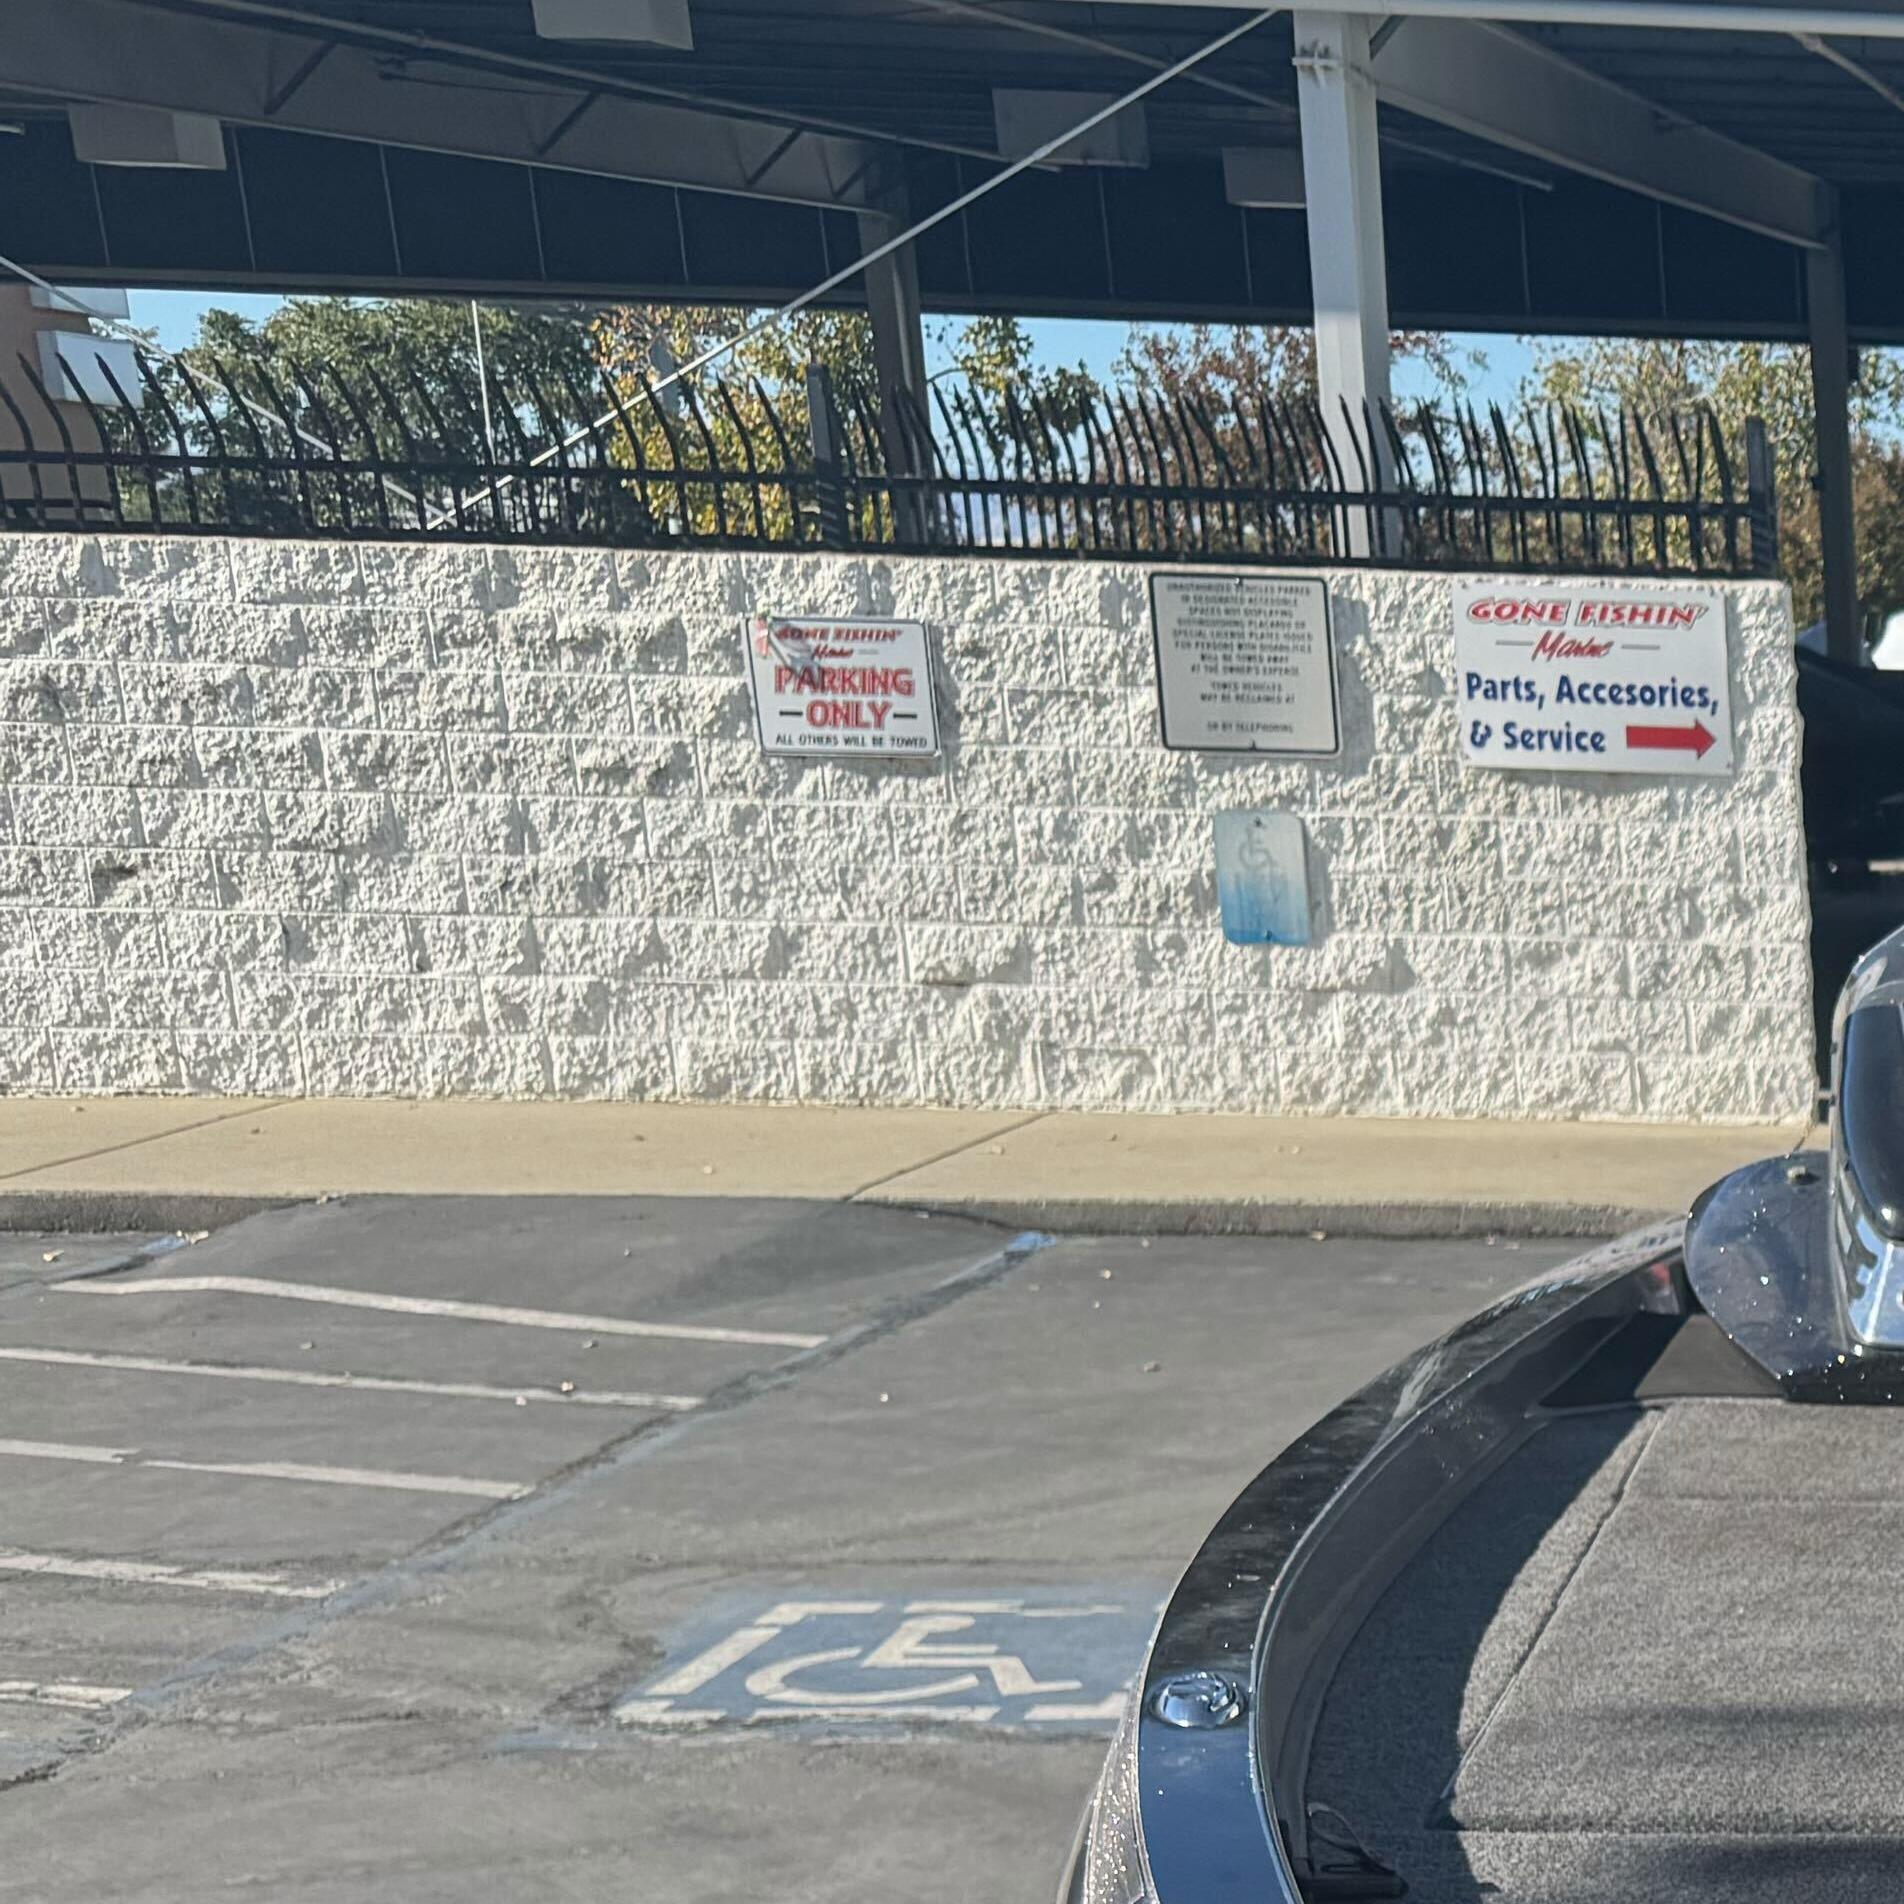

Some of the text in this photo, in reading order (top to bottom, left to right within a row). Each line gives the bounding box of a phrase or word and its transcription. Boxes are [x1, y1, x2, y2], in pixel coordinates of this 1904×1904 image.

[1467, 599, 1571, 628] GONE
[1531, 630, 1615, 662] Marine
[774, 665, 916, 697] PARKING
[1466, 672, 1719, 716] Parts, Accesories,
[806, 699, 893, 731] ONLY
[775, 732, 929, 749] ALL OTHERS WILL BE TOWED
[1470, 720, 1607, 752] & Service
